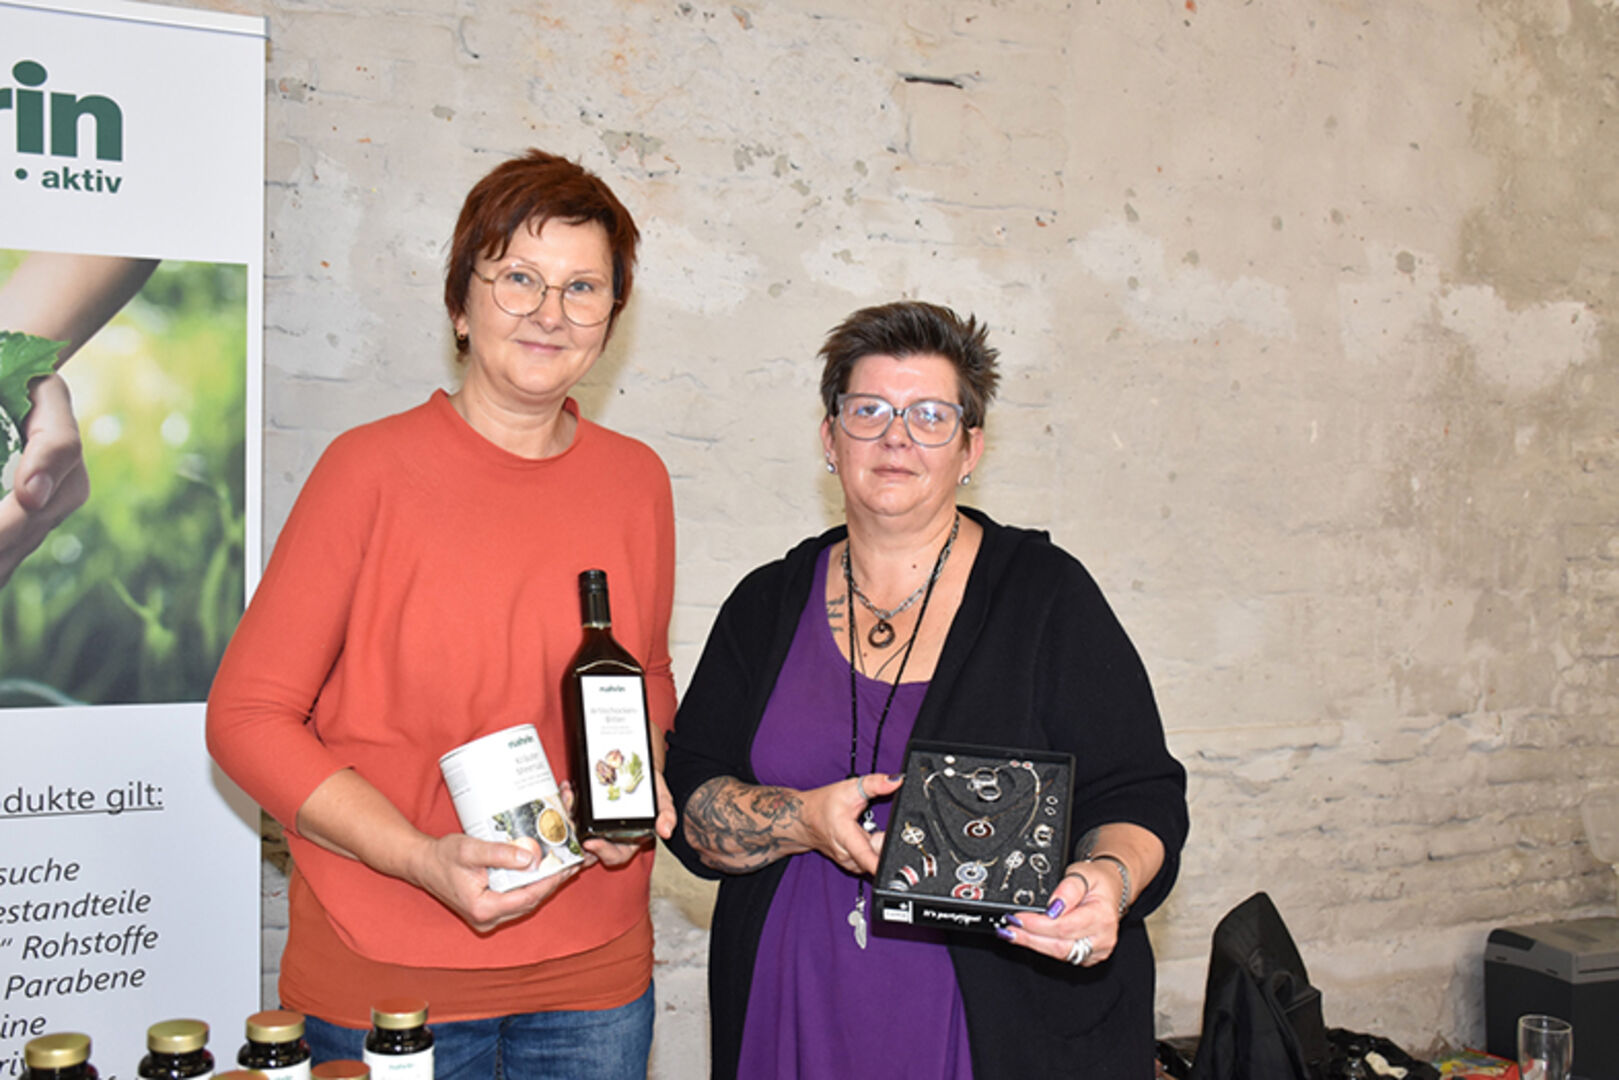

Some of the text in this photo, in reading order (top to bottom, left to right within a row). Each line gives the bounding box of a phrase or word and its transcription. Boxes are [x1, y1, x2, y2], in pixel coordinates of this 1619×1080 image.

[41, 166, 122, 194] aktiv
[105, 781, 164, 815] gilt:
[21, 924, 159, 961] Rohstoffe
[4, 967, 146, 1001] Parabene
